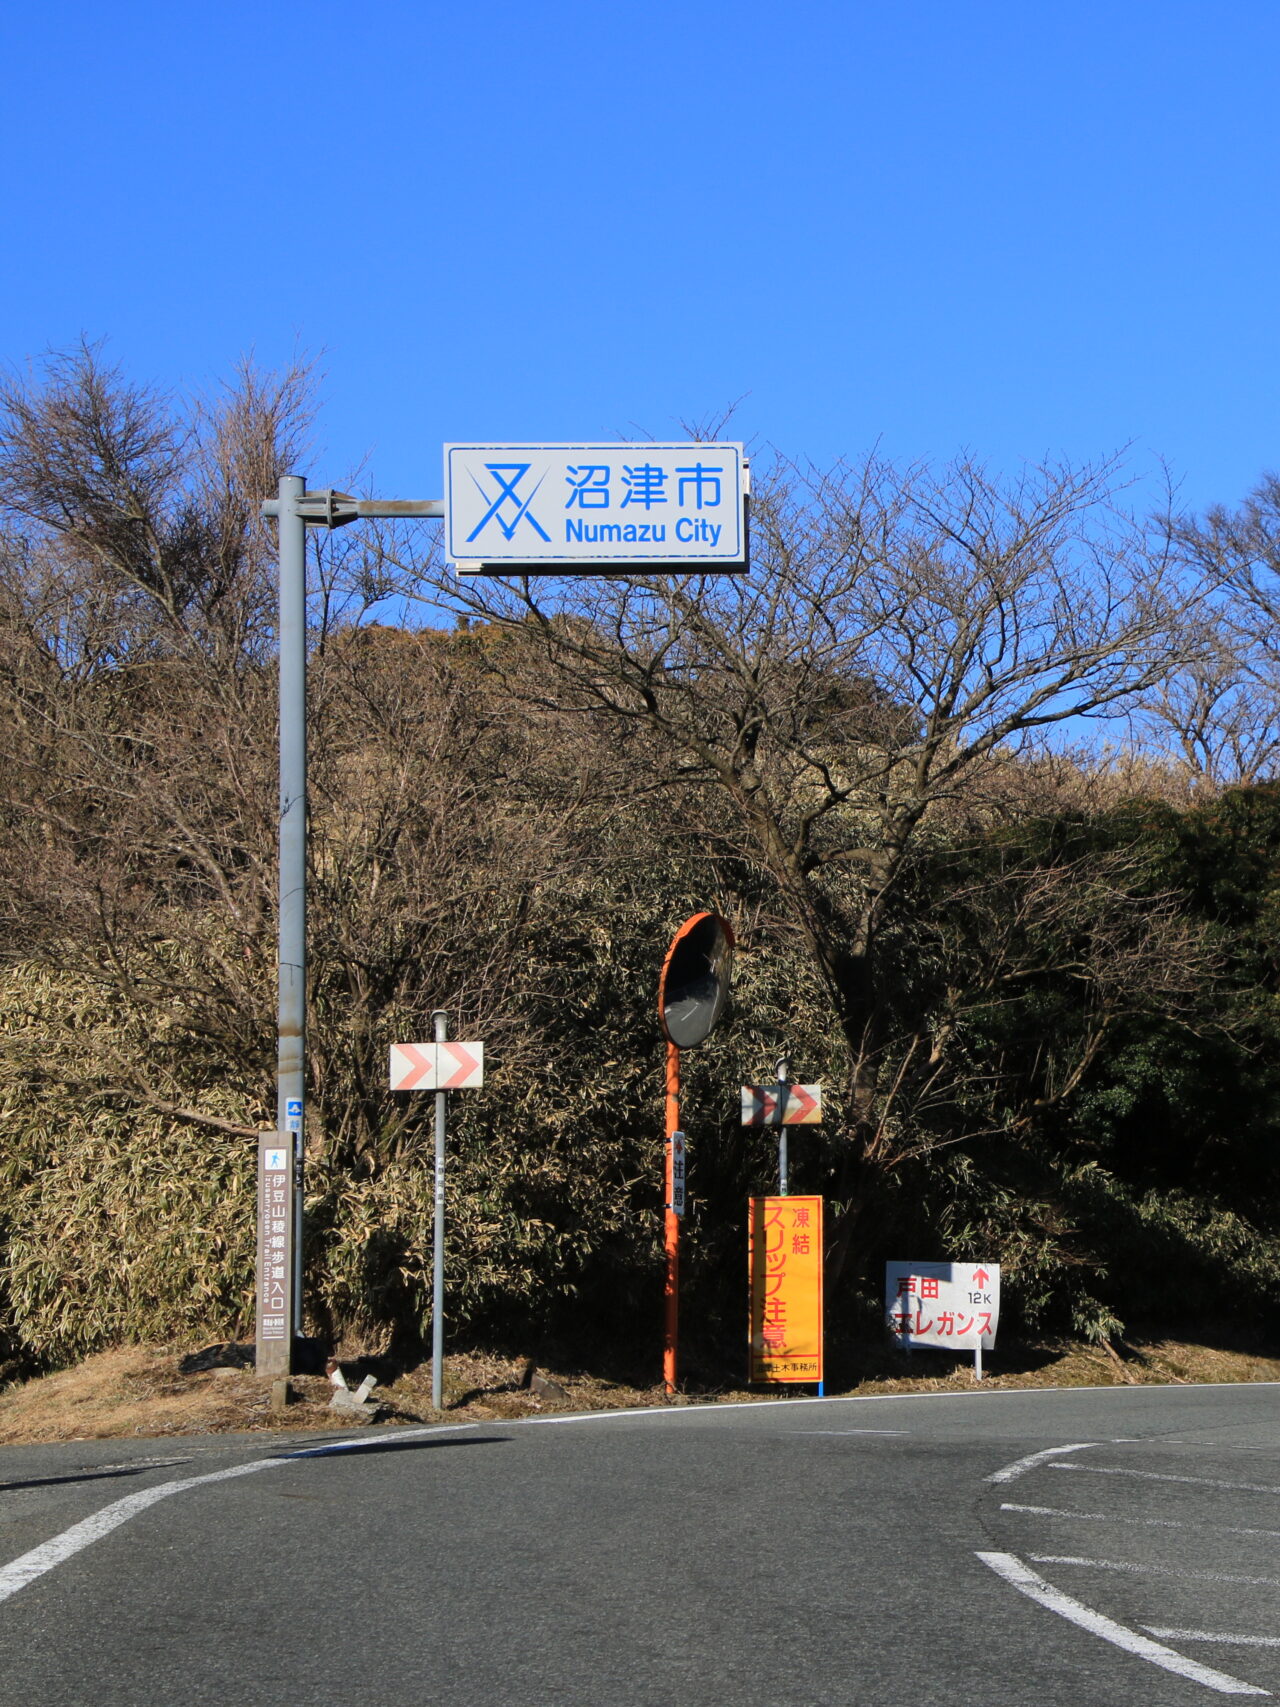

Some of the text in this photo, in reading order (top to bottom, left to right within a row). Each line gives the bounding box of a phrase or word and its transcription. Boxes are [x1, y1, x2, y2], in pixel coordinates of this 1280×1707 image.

[564, 462, 724, 511] 沼津市
[565, 517, 722, 547] Numazu City
[792, 1207, 810, 1255] 凍結
[761, 1206, 787, 1349] スリップ注意
[896, 1277, 939, 1299] 戸田
[967, 1292, 992, 1305] 12K
[894, 1311, 993, 1335] エレガンス
[757, 1362, 817, 1373] 土木事務所
